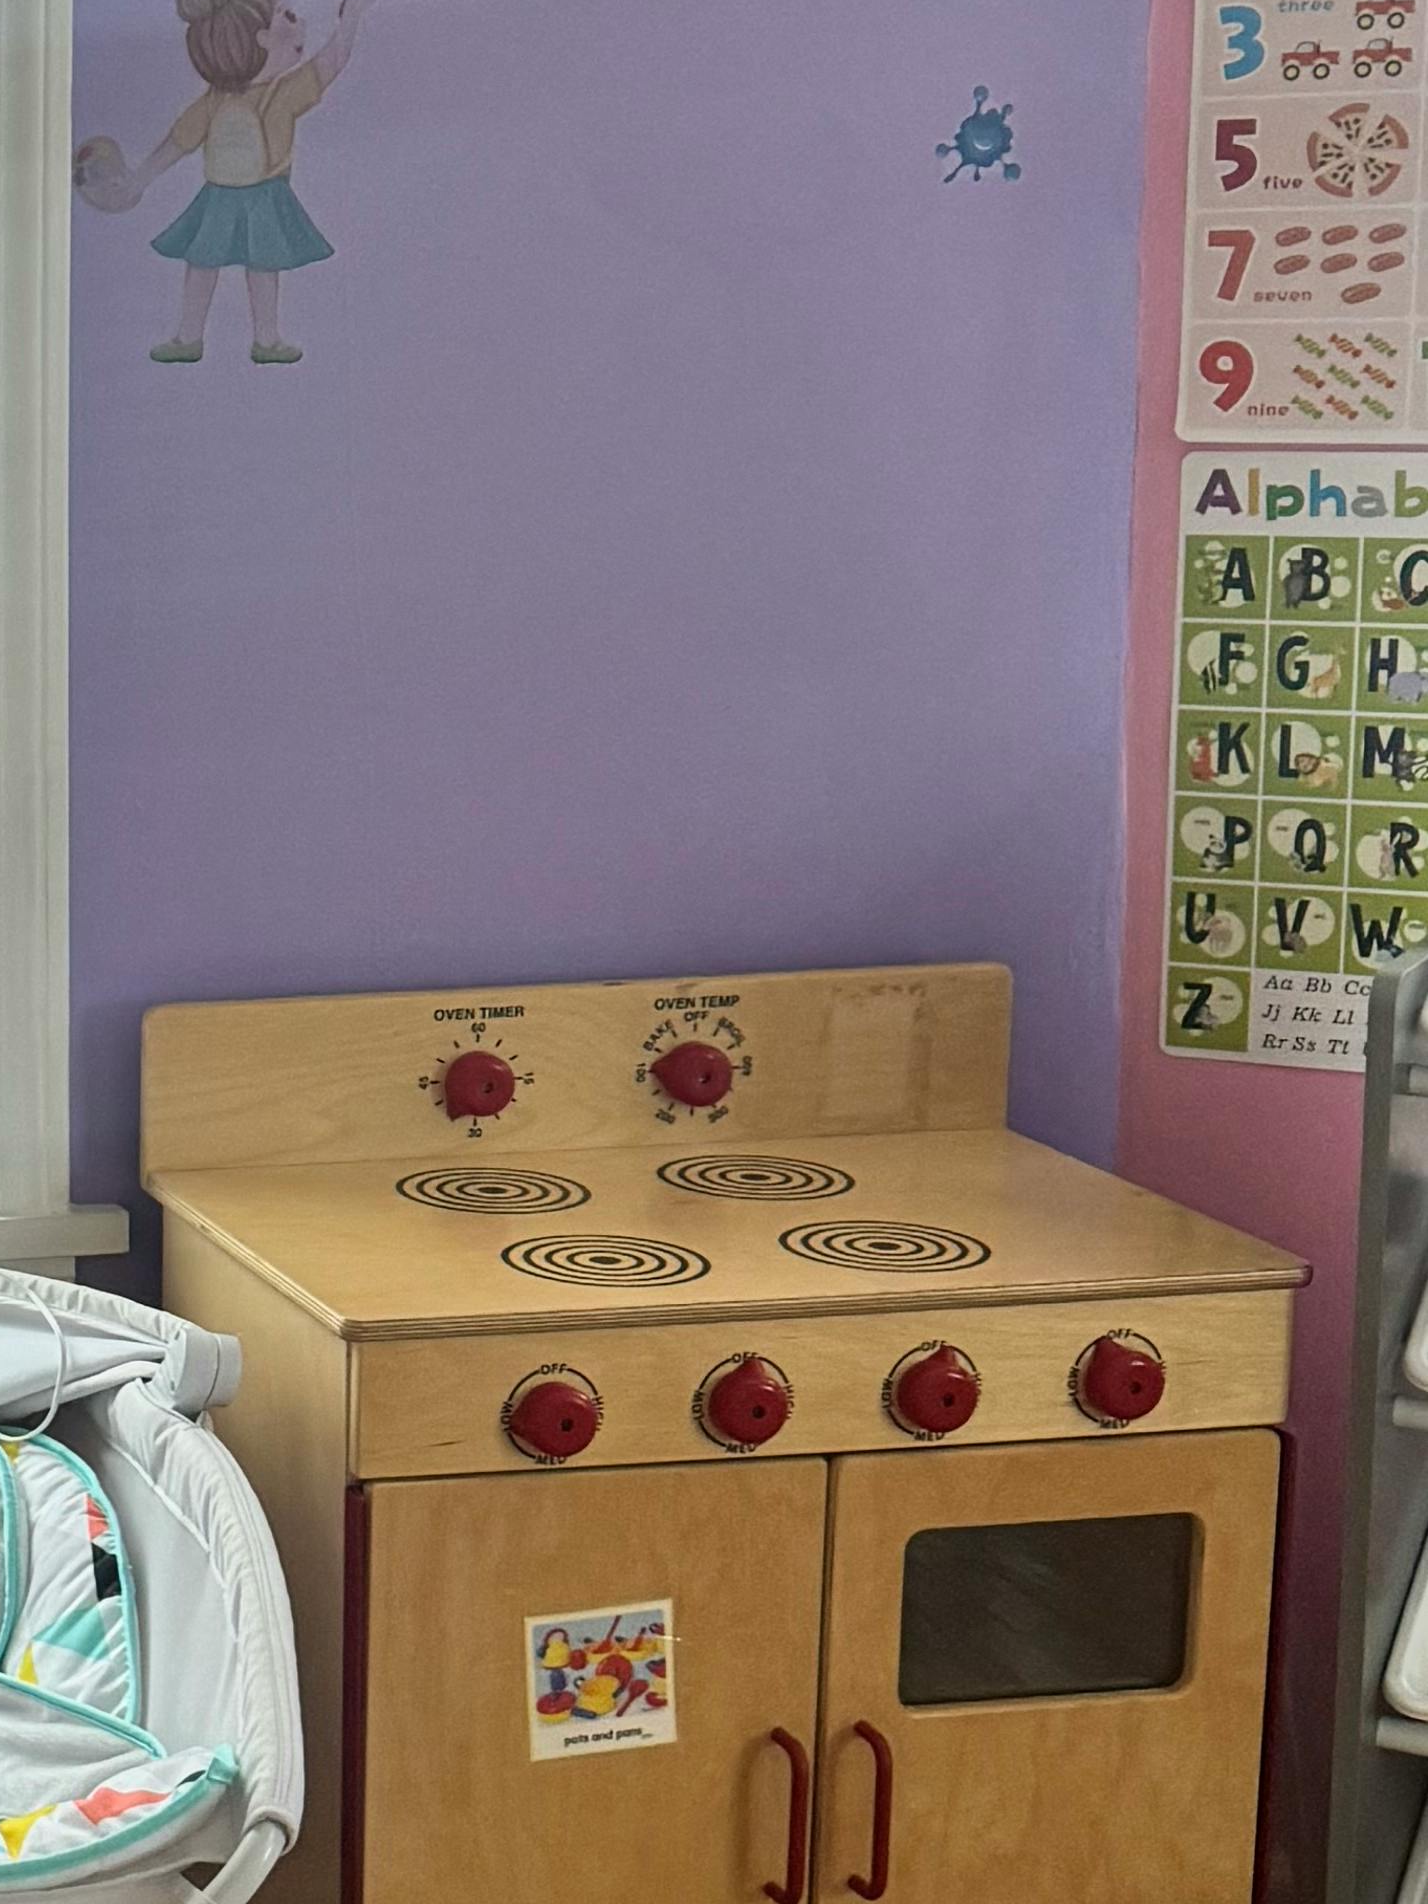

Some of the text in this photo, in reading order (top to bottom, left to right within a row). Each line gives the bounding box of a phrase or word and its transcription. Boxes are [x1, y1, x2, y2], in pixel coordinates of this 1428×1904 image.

[1219, 5, 1265, 80] 3
[1215, 118, 1258, 192] 5
[1263, 175, 1303, 191] five
[1208, 229, 1256, 301] 7
[1253, 288, 1313, 303] seven
[1199, 340, 1254, 412] 9
[1247, 402, 1290, 417] nine
[1218, 547, 1255, 601] A
[1301, 547, 1332, 602] B
[1218, 632, 1246, 686] F
[1276, 635, 1310, 691] G
[1368, 637, 1399, 692] H
[1217, 721, 1252, 775] K
[1278, 724, 1300, 778] L
[1362, 725, 1406, 778] M
[1223, 815, 1253, 868] P
[1294, 818, 1327, 873] Q
[1389, 822, 1420, 878] R
[1184, 891, 1216, 945] U
[1274, 897, 1312, 952] V
[1350, 903, 1405, 958] W
[654, 994, 740, 1010] OVEN TEMP
[1181, 982, 1213, 1030] Z
[1262, 975, 1372, 997] Aa Bb Cc
[433, 1005, 525, 1021] OVEN TIMER
[683, 1010, 710, 1022] OFF
[1261, 1004, 1354, 1026] Jj Kk Ll
[643, 1018, 673, 1051] BAKE
[1262, 1033, 1350, 1055] Rr Ss Tt
[920, 1339, 947, 1352] OFF
[1107, 1328, 1134, 1340] OFF
[539, 1362, 567, 1375] OFF
[731, 1351, 759, 1364] OFF
[880, 1377, 892, 1409] LOW
[1067, 1365, 1079, 1396] LOW
[500, 1400, 513, 1432] LOW
[692, 1388, 705, 1421] LOW
[591, 1728, 614, 1741] and
